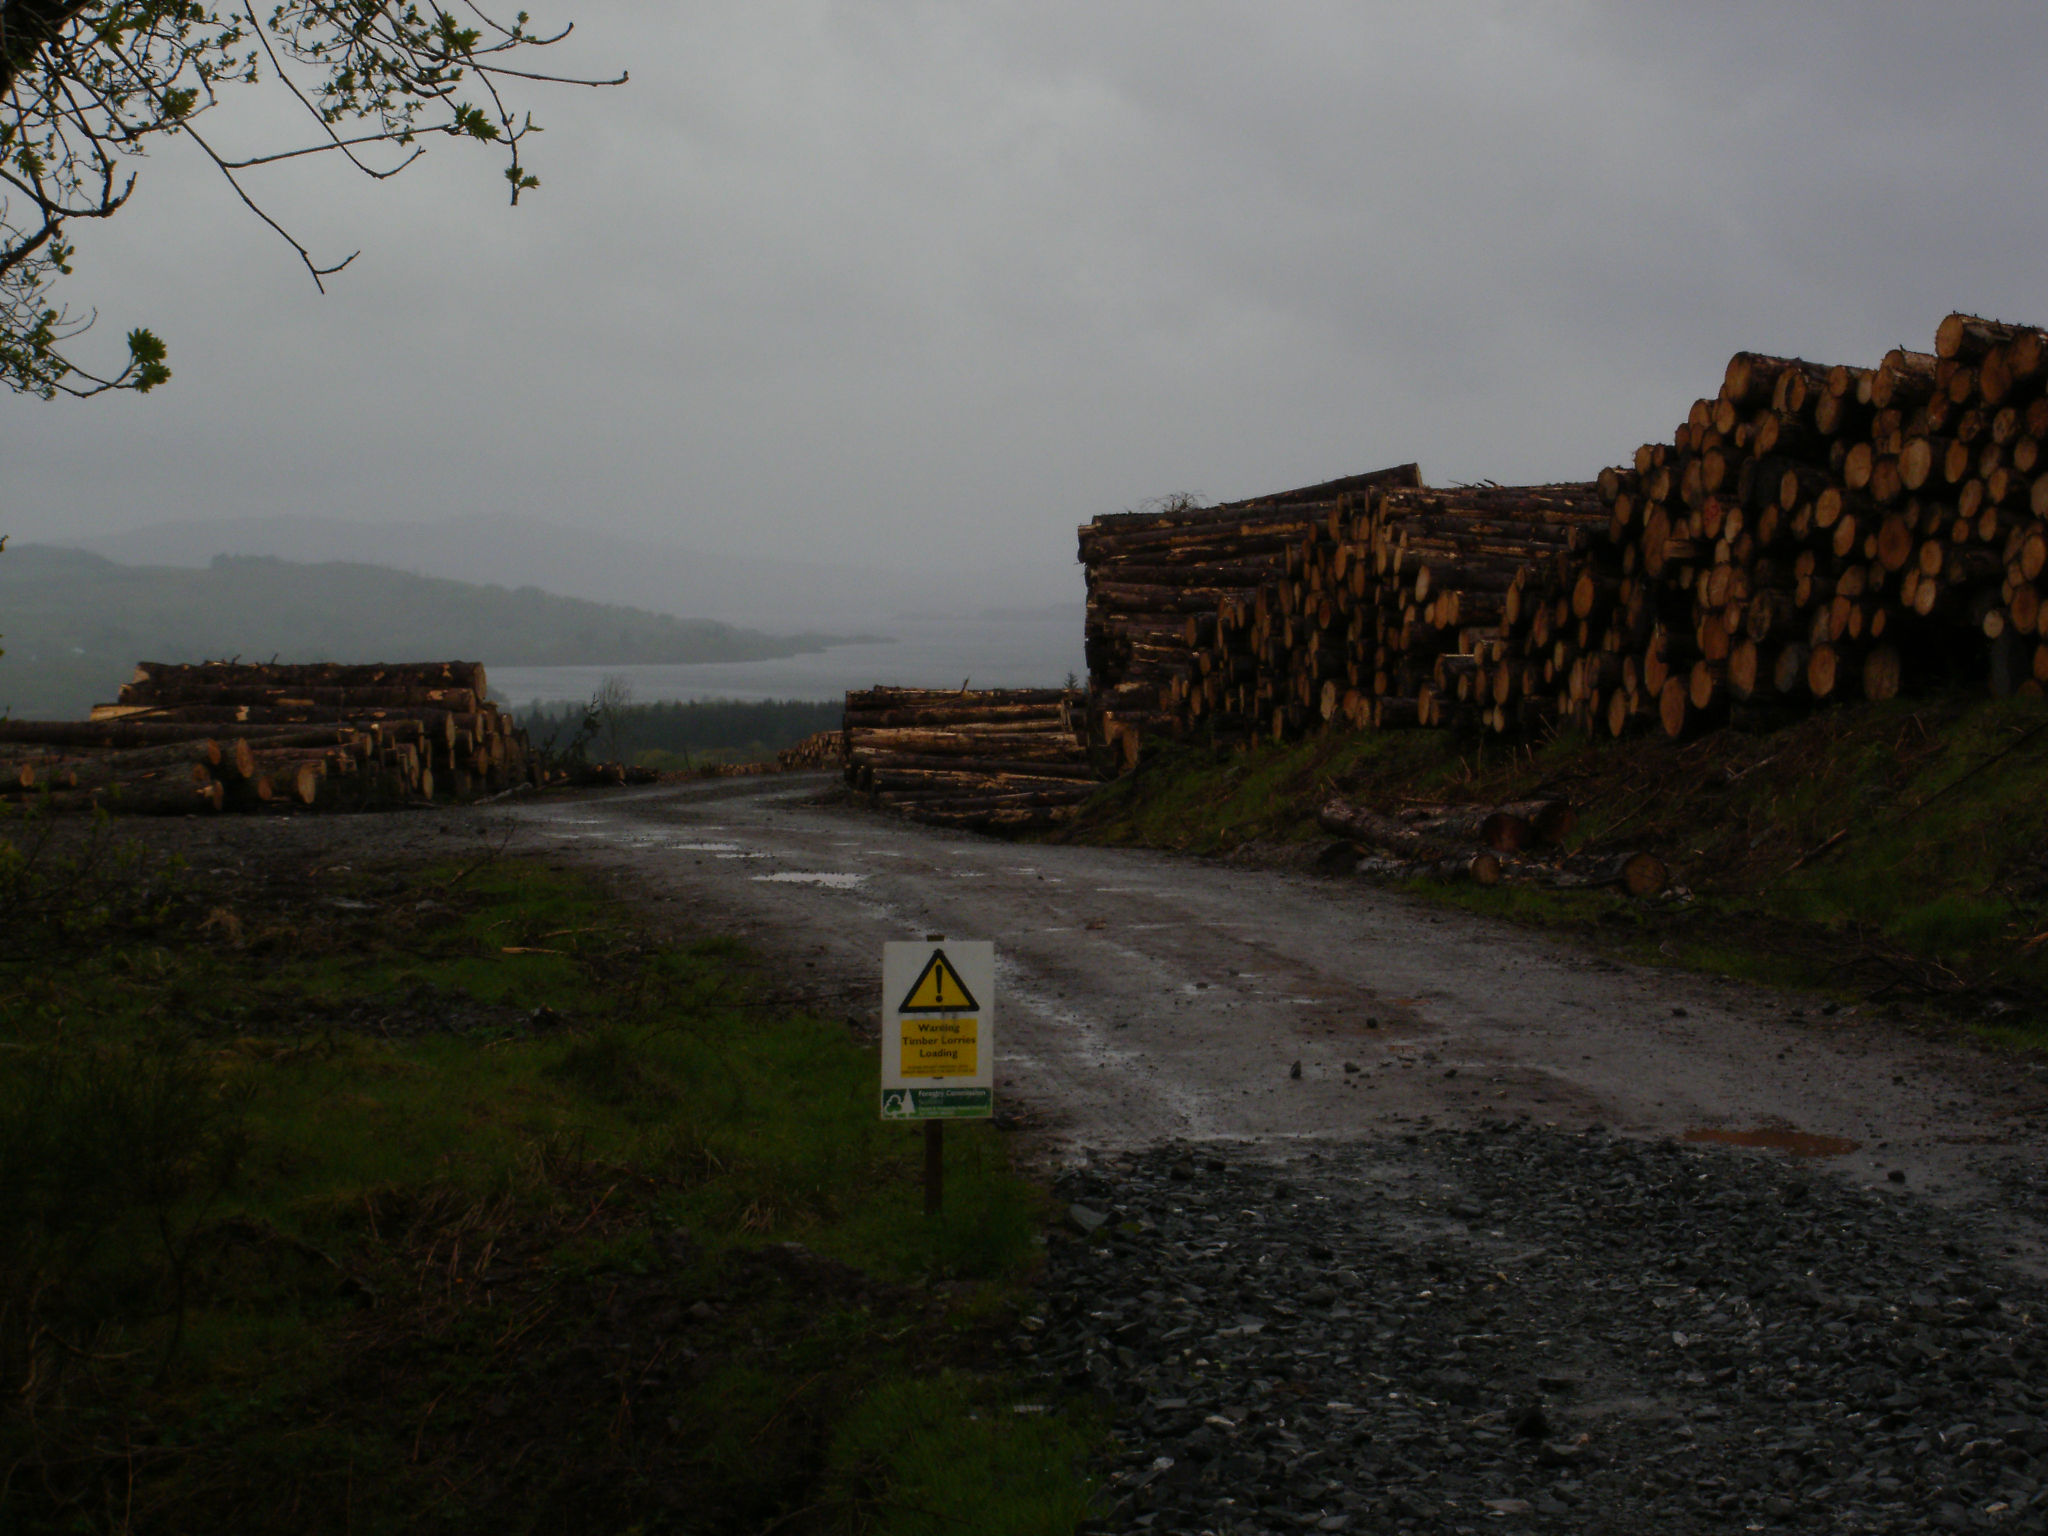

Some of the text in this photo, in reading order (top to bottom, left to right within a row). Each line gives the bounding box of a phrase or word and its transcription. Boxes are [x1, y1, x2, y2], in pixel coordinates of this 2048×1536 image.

[918, 1024, 960, 1034] Warning
[902, 1035, 976, 1045] Timber Lorries
[919, 1048, 958, 1059] Loading
